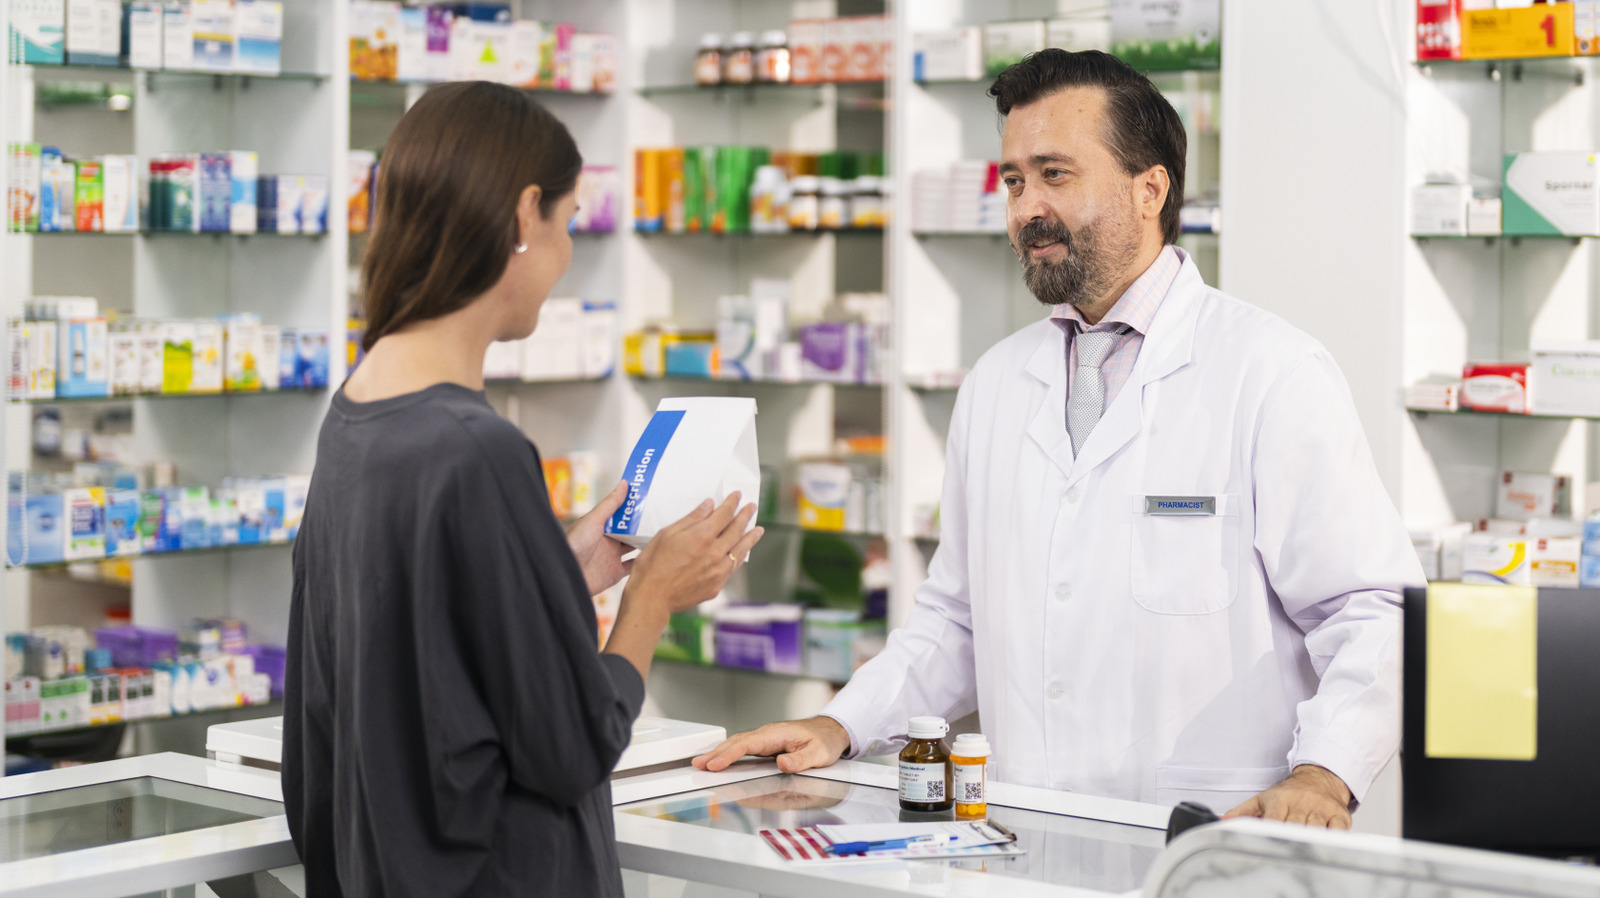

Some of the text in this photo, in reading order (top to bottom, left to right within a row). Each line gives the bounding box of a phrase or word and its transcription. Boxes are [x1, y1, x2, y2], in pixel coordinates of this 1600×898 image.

[1540, 14, 1554, 47] 1
[617, 448, 655, 529] Prescription
[1158, 501, 1204, 509] PHARMACIST
